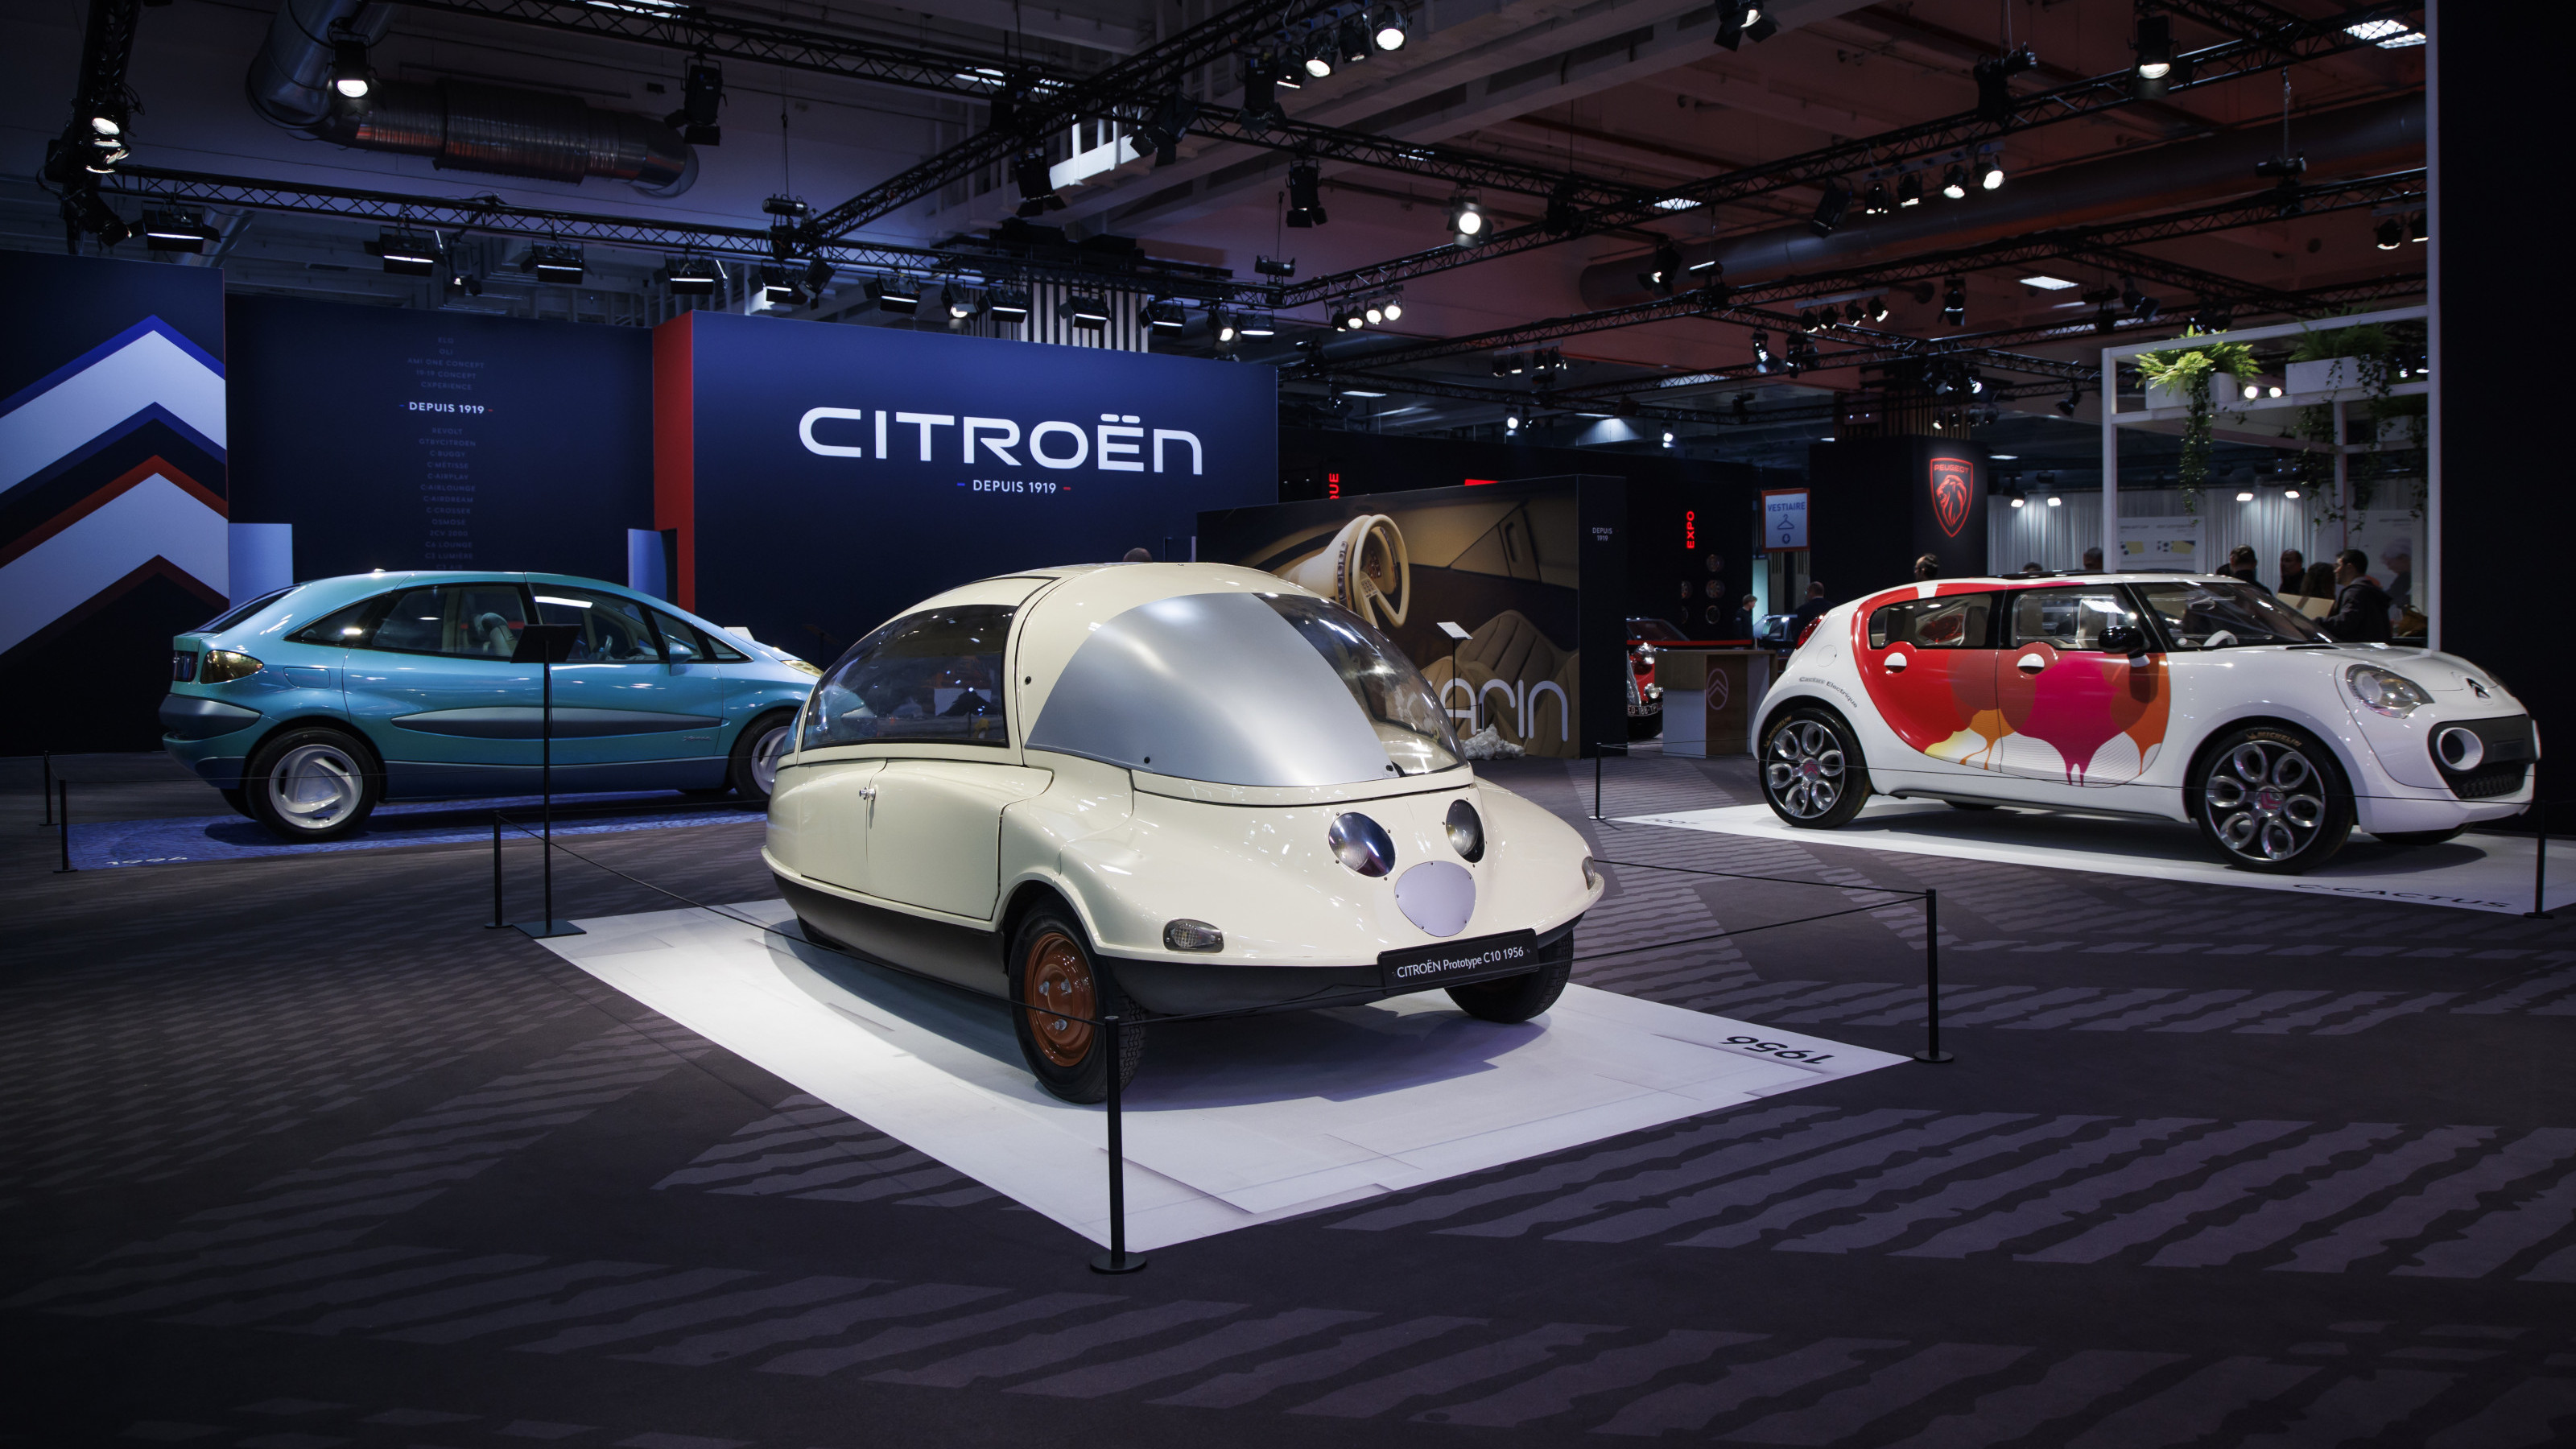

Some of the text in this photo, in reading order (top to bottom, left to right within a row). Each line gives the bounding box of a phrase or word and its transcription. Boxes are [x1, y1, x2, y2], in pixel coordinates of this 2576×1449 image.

[425, 358, 444, 366] ONE
[446, 361, 485, 369] CONCEPT
[437, 370, 477, 379] CONCEPT
[420, 382, 473, 390] CXPERIENCE
[409, 401, 485, 415] DEPUIS 1919
[431, 427, 463, 436] REVOLT
[799, 407, 1203, 476] CITROËN
[1933, 464, 1970, 474] PEUGEOT
[972, 479, 1057, 494] DEPUIS 1919
[1767, 502, 1806, 512] VESTIAIRE
[1591, 526, 1613, 535] DEPUIS
[1686, 510, 1695, 550] EXPO
[1798, 676, 1858, 708] Cactus Electrique
[2292, 883, 2512, 909] C-CACTUS
[1397, 946, 1525, 978] CITROËN Prototype C10 1956
[1718, 1035, 1836, 1064] 1956
